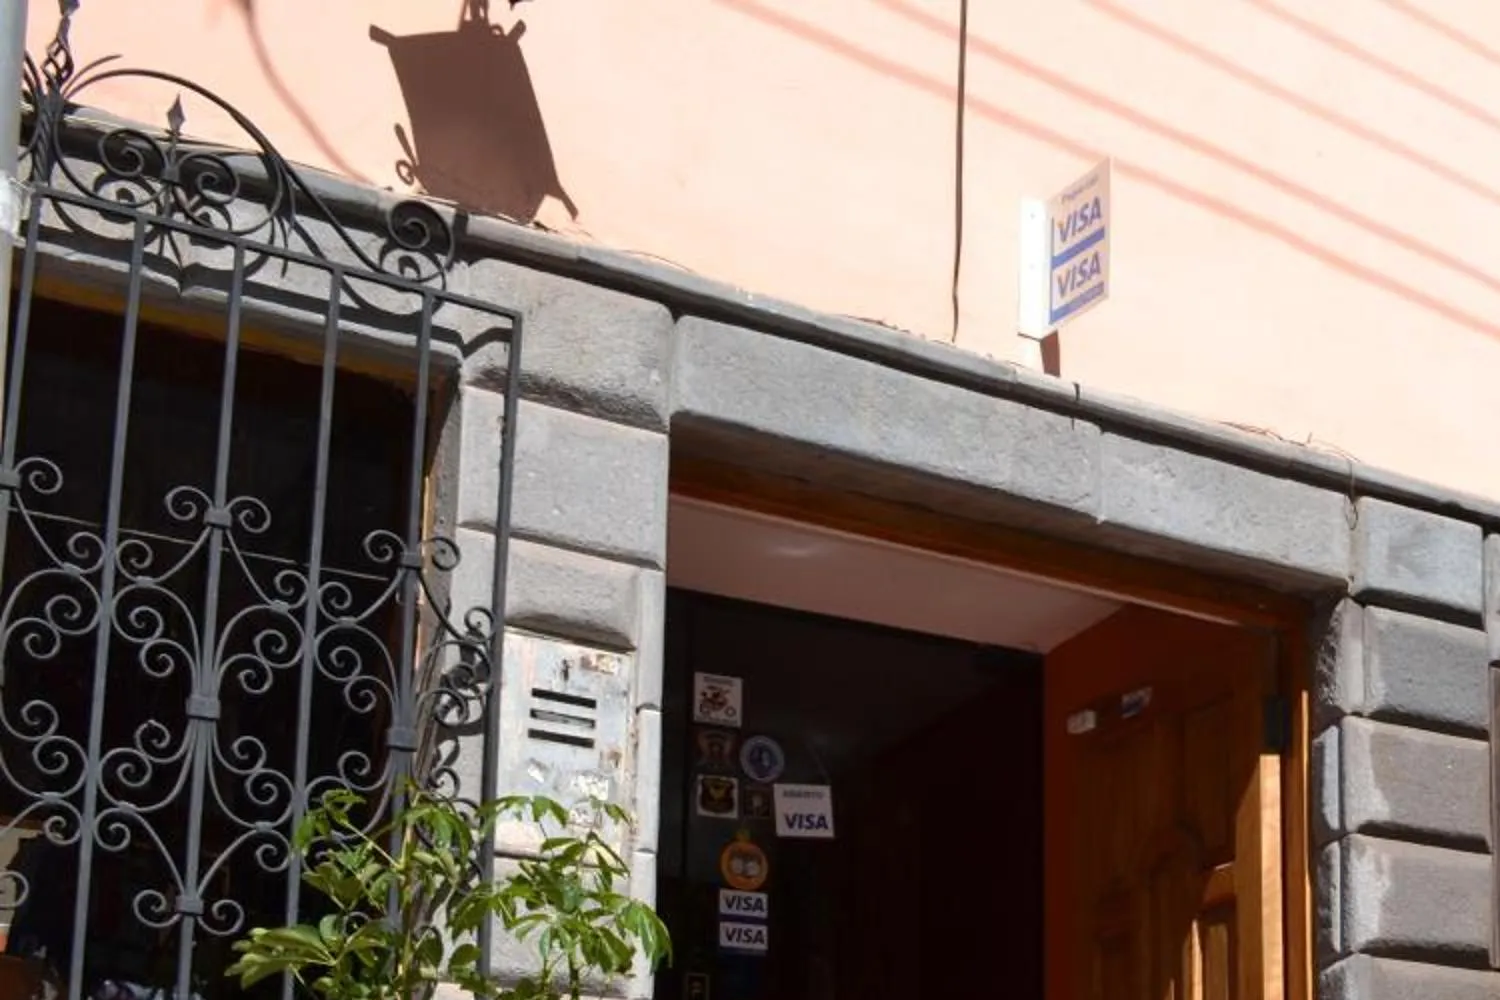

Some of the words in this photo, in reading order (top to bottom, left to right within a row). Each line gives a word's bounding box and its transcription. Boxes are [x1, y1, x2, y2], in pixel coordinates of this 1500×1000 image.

[1057, 197, 1102, 242] VISA
[1057, 252, 1101, 297] VISA
[783, 813, 829, 830] VISA
[725, 895, 765, 913] VISA
[725, 928, 765, 945] VISA
